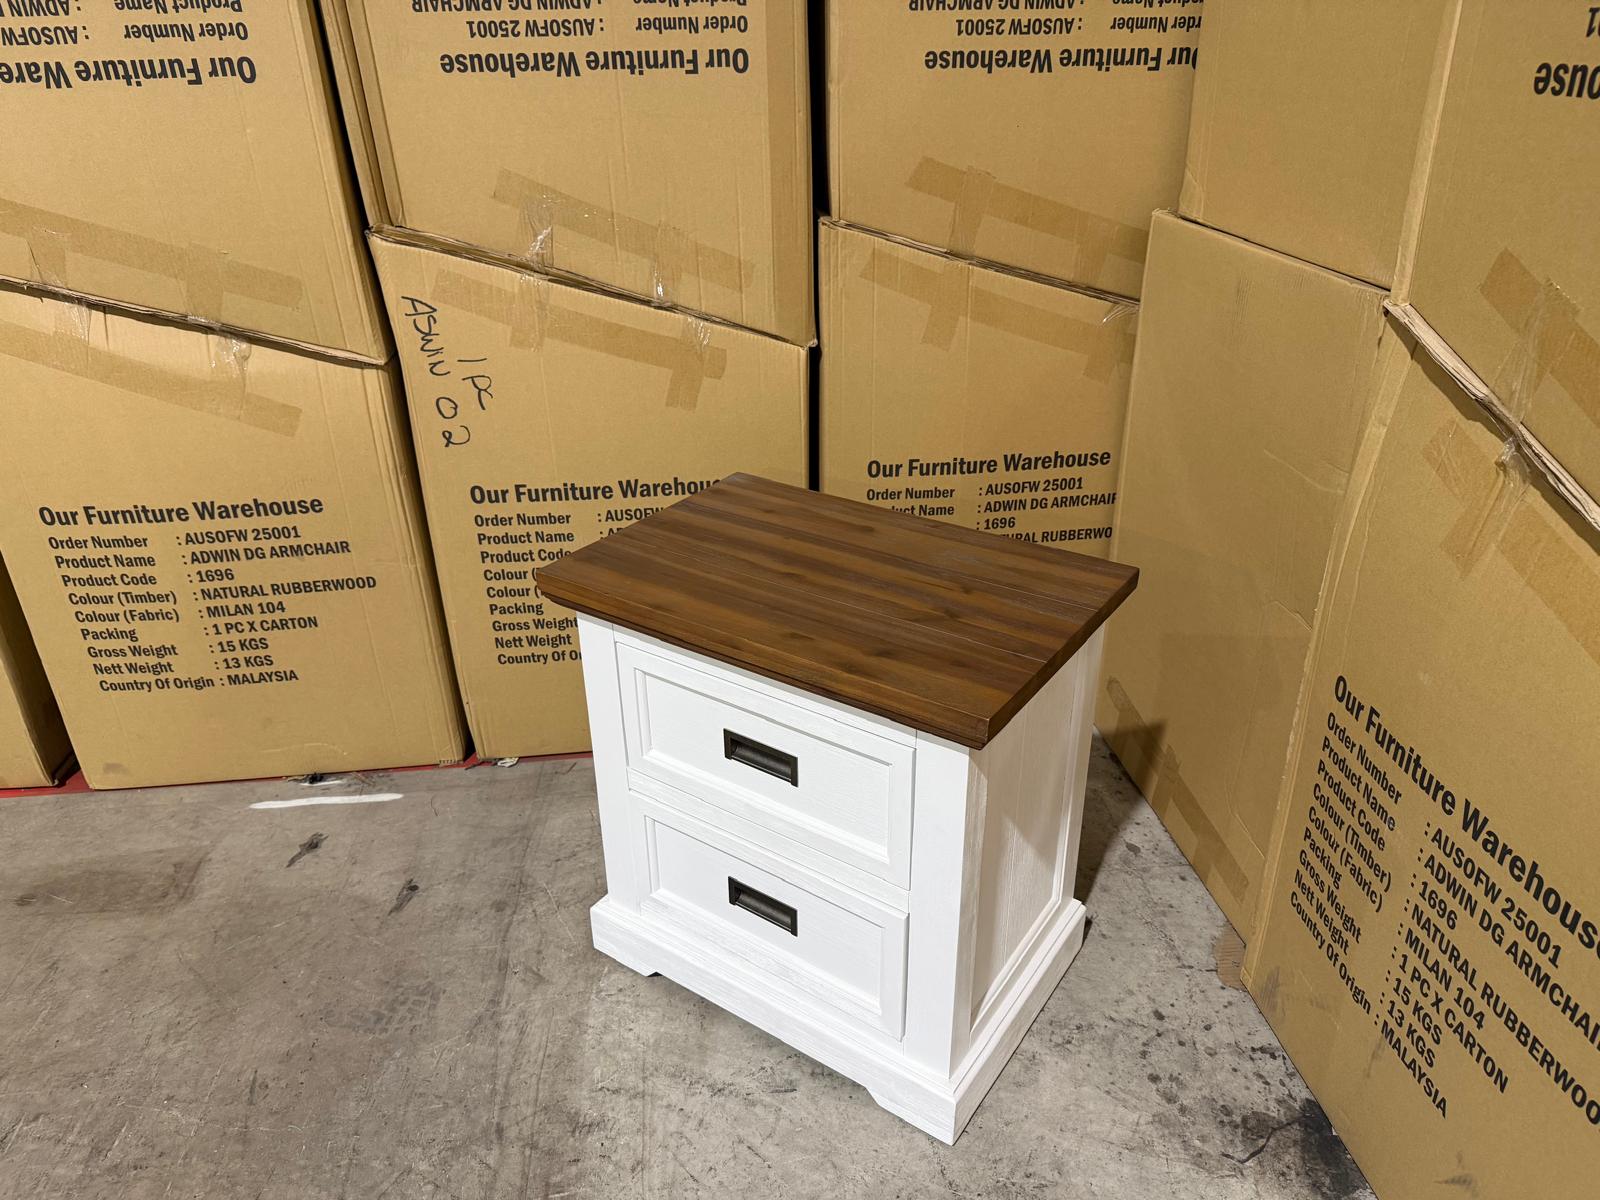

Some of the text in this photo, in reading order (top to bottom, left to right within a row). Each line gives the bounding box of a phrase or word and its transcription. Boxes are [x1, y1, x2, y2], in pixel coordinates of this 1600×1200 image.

[6, 0, 70, 18] ADWIN
[0, 21, 249, 47] Order Number AUSOFW
[465, 15, 749, 39] Order Number AUSOFW 25001
[955, 15, 1203, 37] rder Number AUSOFW 25001
[73, 57, 203, 87] Furniture
[207, 56, 257, 84] Our
[439, 47, 749, 79] Our Furniture Warehouse
[924, 46, 1199, 75] ur Furniture Warehouse
[867, 450, 1112, 479] Our Furniture Warehouse
[469, 476, 721, 505] Our Furniture Warehou
[866, 476, 1084, 501] Order Number AUSOFW 25001
[38, 498, 324, 526] Our Furniture Warehouse
[918, 504, 955, 517] Name
[983, 498, 1027, 514] ADWIN
[1029, 497, 1049, 511] DG
[474, 513, 514, 528] Order
[516, 512, 572, 526] Number
[983, 516, 1016, 530] 1696
[47, 525, 302, 550] Order Number AUSOFW 25001
[476, 530, 575, 546] Product Name
[1040, 526, 1113, 543] RUBBERWO
[54, 540, 352, 569] Product Name ADWIN DG ARMCHAIR
[480, 549, 536, 564] Product
[60, 567, 235, 588] Product Code 1696
[483, 568, 529, 582] Colour
[68, 576, 377, 607] Colour (Timber) NATURAL RUBBERWOOD
[486, 585, 531, 599] Colour
[74, 600, 287, 625] Colour (Fabric) MILAN 104
[488, 601, 545, 616] Packing
[80, 615, 319, 643] Packing 1 PC X CARTON
[491, 616, 579, 632] Gross Weight
[87, 637, 269, 659] Gross Weight 15 KGS
[494, 633, 573, 649] Nett Weight
[92, 654, 274, 676] Nett Weight 13 KGS
[497, 652, 549, 665] Country
[551, 649, 567, 662] Of
[99, 669, 300, 693] Country Of Origin MALAYSIA
[1334, 675, 1600, 960] Our Furniture Warehous
[1317, 758, 1458, 931] Product Code 1696
[1327, 711, 1562, 969] Order Number AUSOFW 25001
[1321, 735, 1600, 1045] Product Name ADWIN DG ARMCHAI
[1308, 805, 1486, 1031] Colour (Fabric) MILAN 104
[1299, 849, 1443, 1046] Gross Weight 15 KGS
[1303, 826, 1509, 1094] Packing 1 PC X CARTON
[1313, 782, 1600, 1126] Colour (Timber) NATURAL RUBBERWOO
[1294, 868, 1436, 1069] Nett Weight 13 KGS
[1290, 890, 1447, 1119] Country Of Origin MALAYSIA
